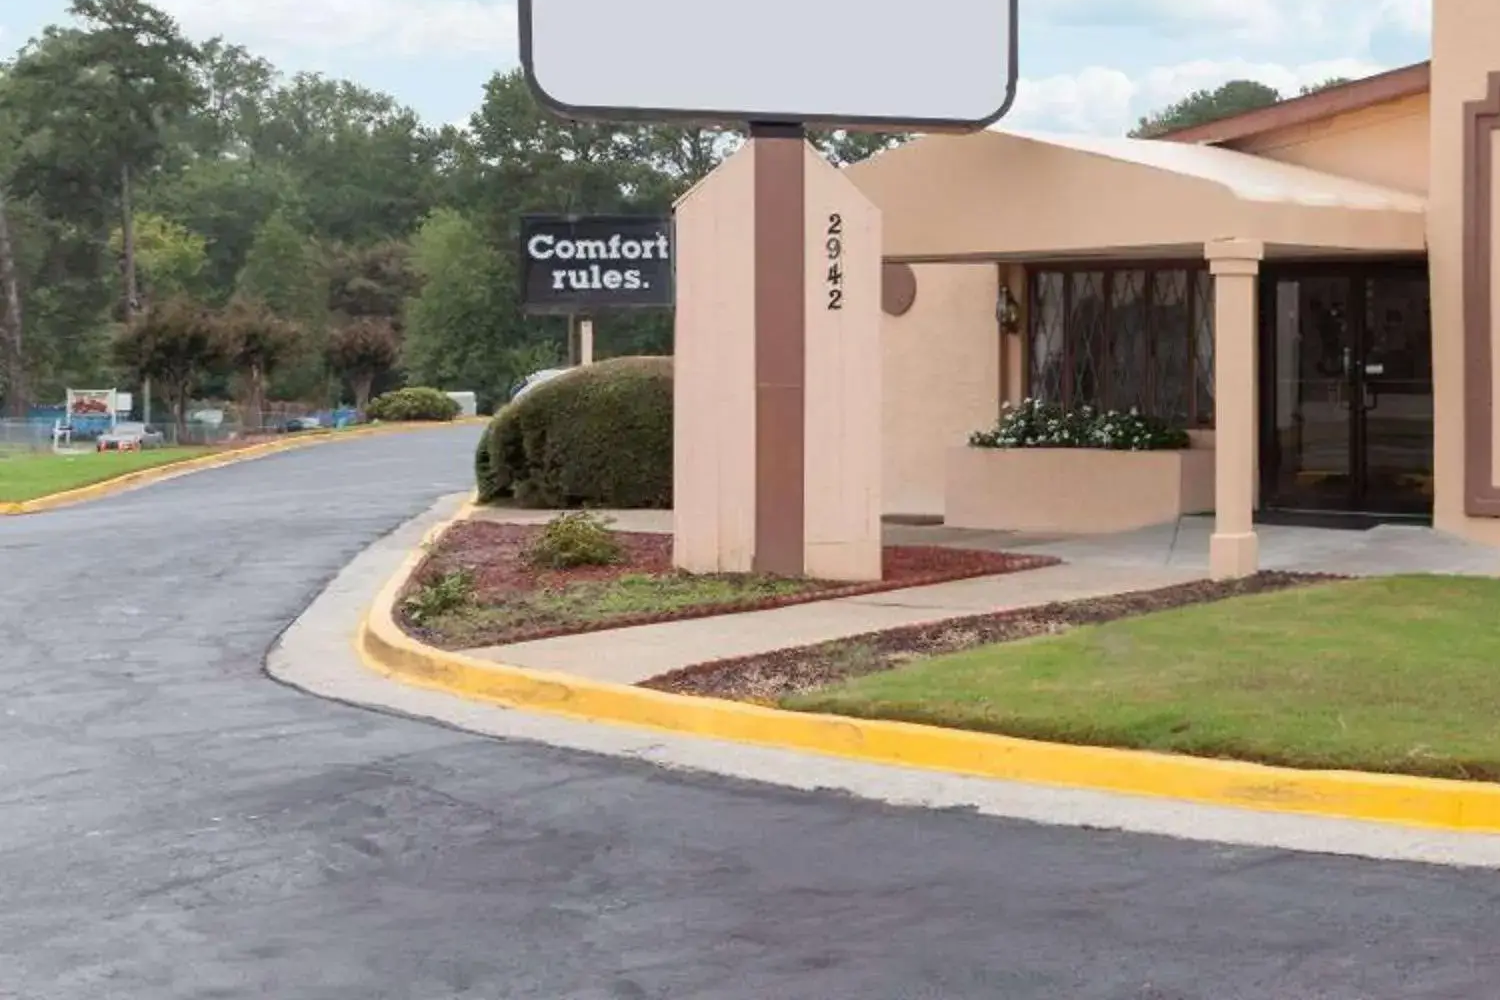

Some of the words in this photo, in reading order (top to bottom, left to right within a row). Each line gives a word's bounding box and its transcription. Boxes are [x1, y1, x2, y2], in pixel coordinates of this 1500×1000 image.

[527, 232, 669, 260] Comfort
[826, 213, 843, 310] 2942
[552, 265, 650, 290] rules.
